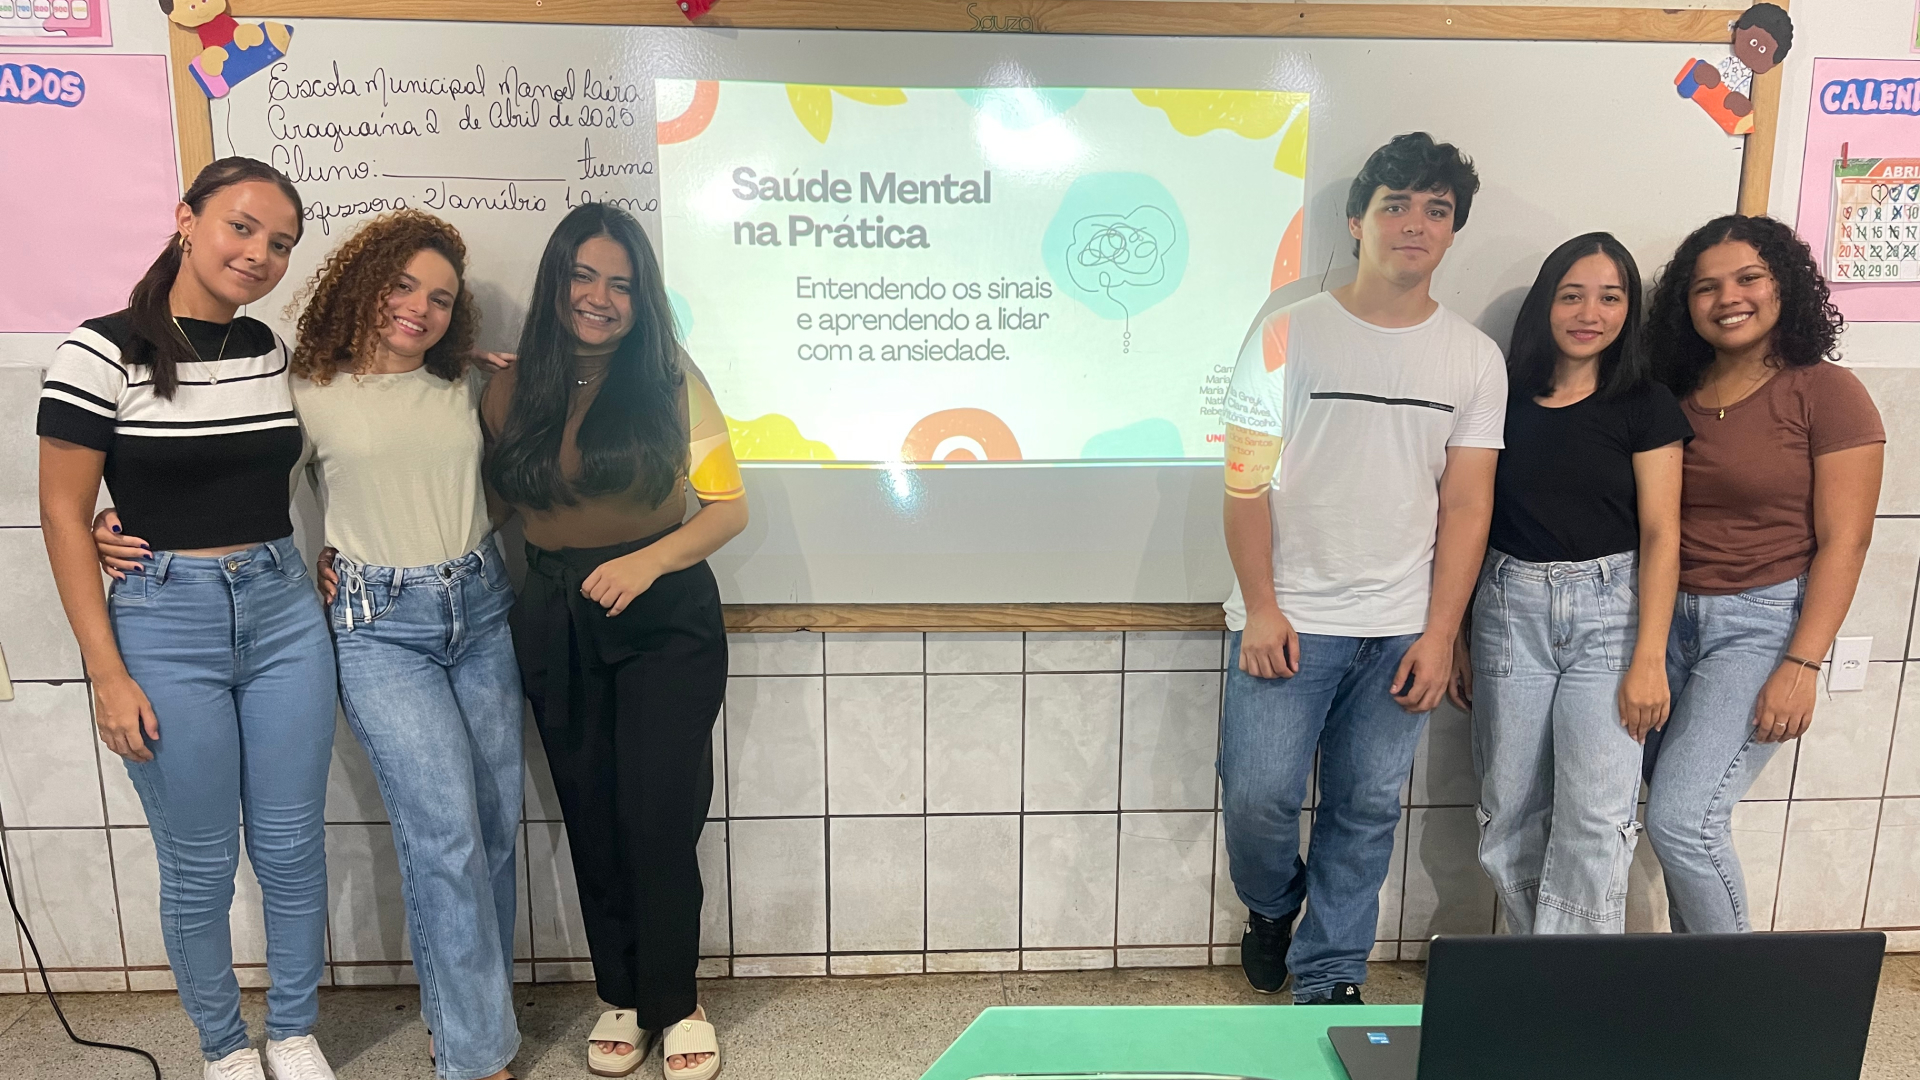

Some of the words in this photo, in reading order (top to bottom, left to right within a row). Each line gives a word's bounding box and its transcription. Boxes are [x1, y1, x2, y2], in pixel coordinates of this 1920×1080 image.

[966, 2, 1034, 32] Souza
[0, 66, 82, 103] ADOS
[268, 60, 361, 103] Escola
[365, 64, 485, 107] Municipal
[498, 65, 576, 107] Manoel
[425, 108, 440, 134] 2
[458, 103, 482, 130] de
[489, 97, 540, 129] Abril
[549, 101, 574, 128] de
[578, 105, 635, 129] 2025
[731, 166, 853, 203] Saúde
[859, 169, 992, 205] Mental
[302, 195, 419, 236] ofessora:
[733, 220, 782, 247] na
[788, 214, 931, 250] Prática
[1839, 244, 1851, 258] 20
[1868, 264, 1882, 277] 29
[1884, 264, 1899, 277] 30
[796, 276, 946, 300] Entendendo
[952, 281, 982, 300] os
[987, 275, 1053, 300] sinais
[796, 312, 813, 331] e
[818, 307, 970, 336] aprendendo
[975, 312, 993, 331] a
[998, 306, 1050, 331] lidar
[797, 342, 853, 362] com
[858, 342, 876, 362] a
[881, 338, 1010, 362] ansiedade.
[1199, 386, 1225, 395] Maria
